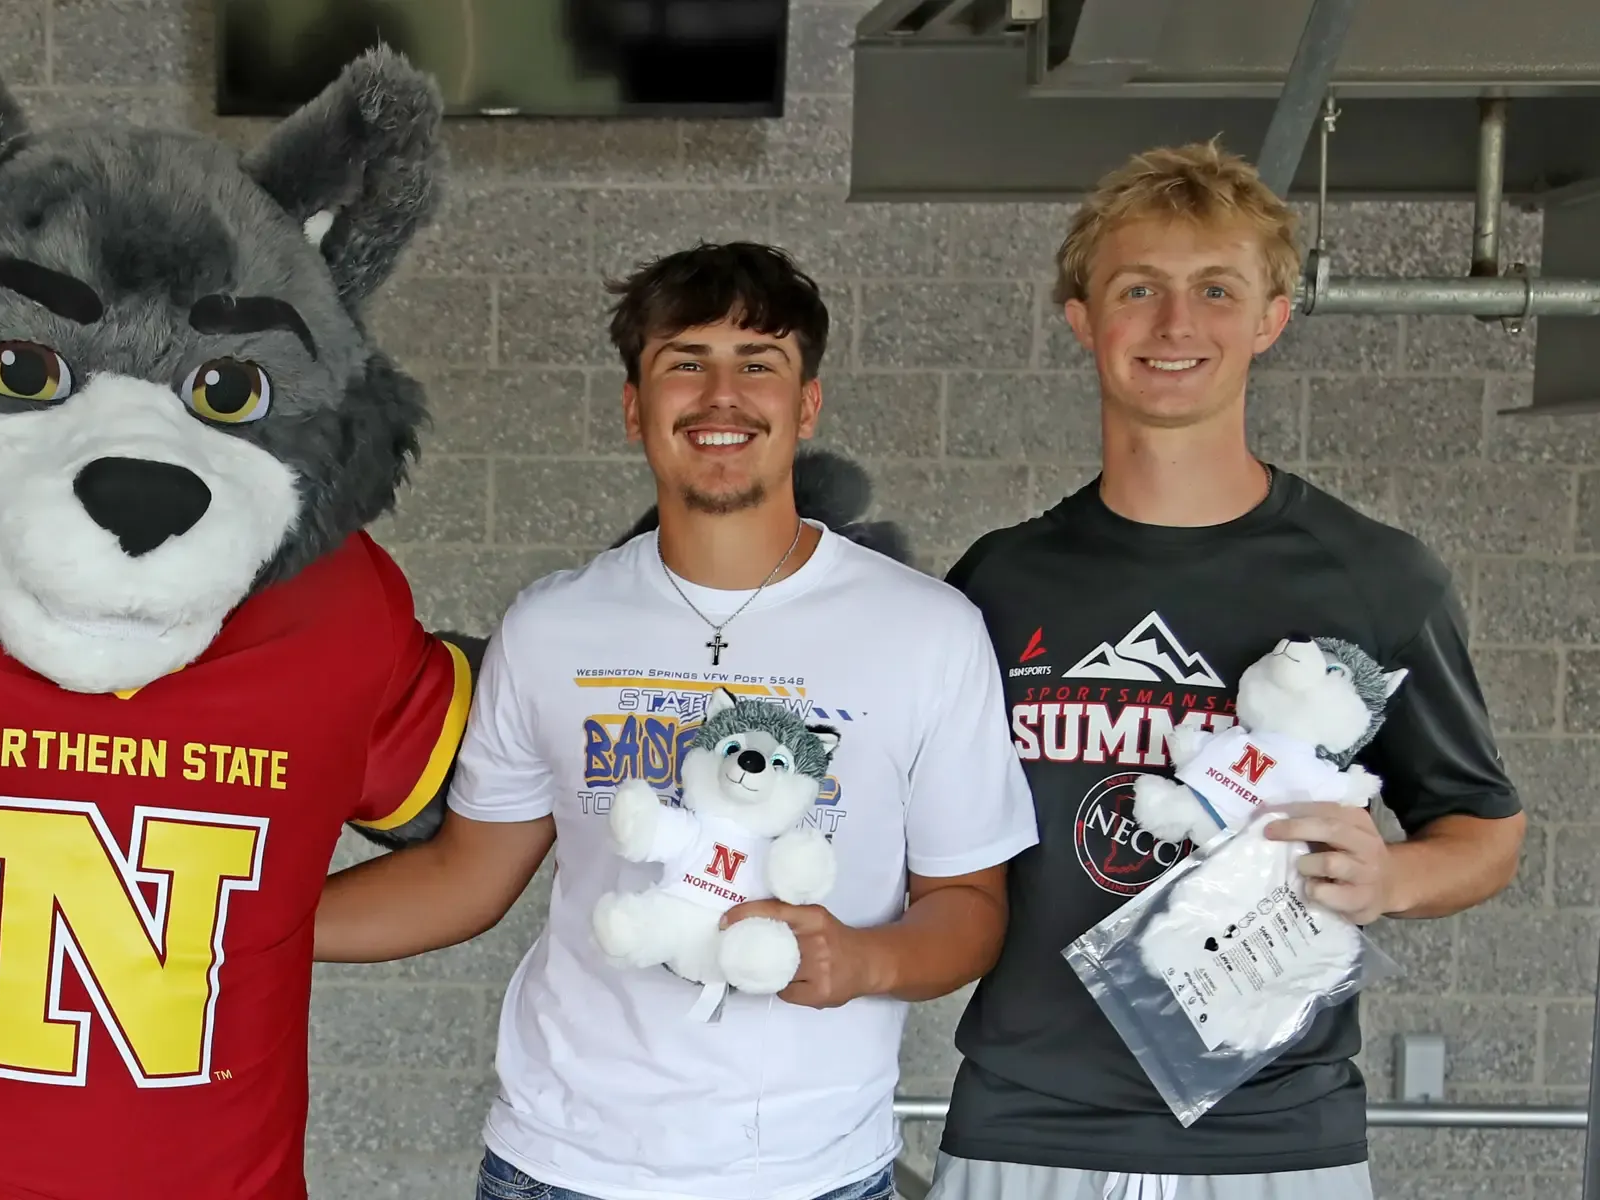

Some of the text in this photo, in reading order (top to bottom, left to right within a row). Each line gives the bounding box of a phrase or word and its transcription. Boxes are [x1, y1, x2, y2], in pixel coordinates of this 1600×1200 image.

[576, 668, 805, 686] WESSINGTON SPRINGS VFW POST 5548
[183, 742, 289, 790] STATE
[1228, 742, 1278, 786] N
[704, 841, 749, 884] N
[213, 1069, 233, 1081] TM
